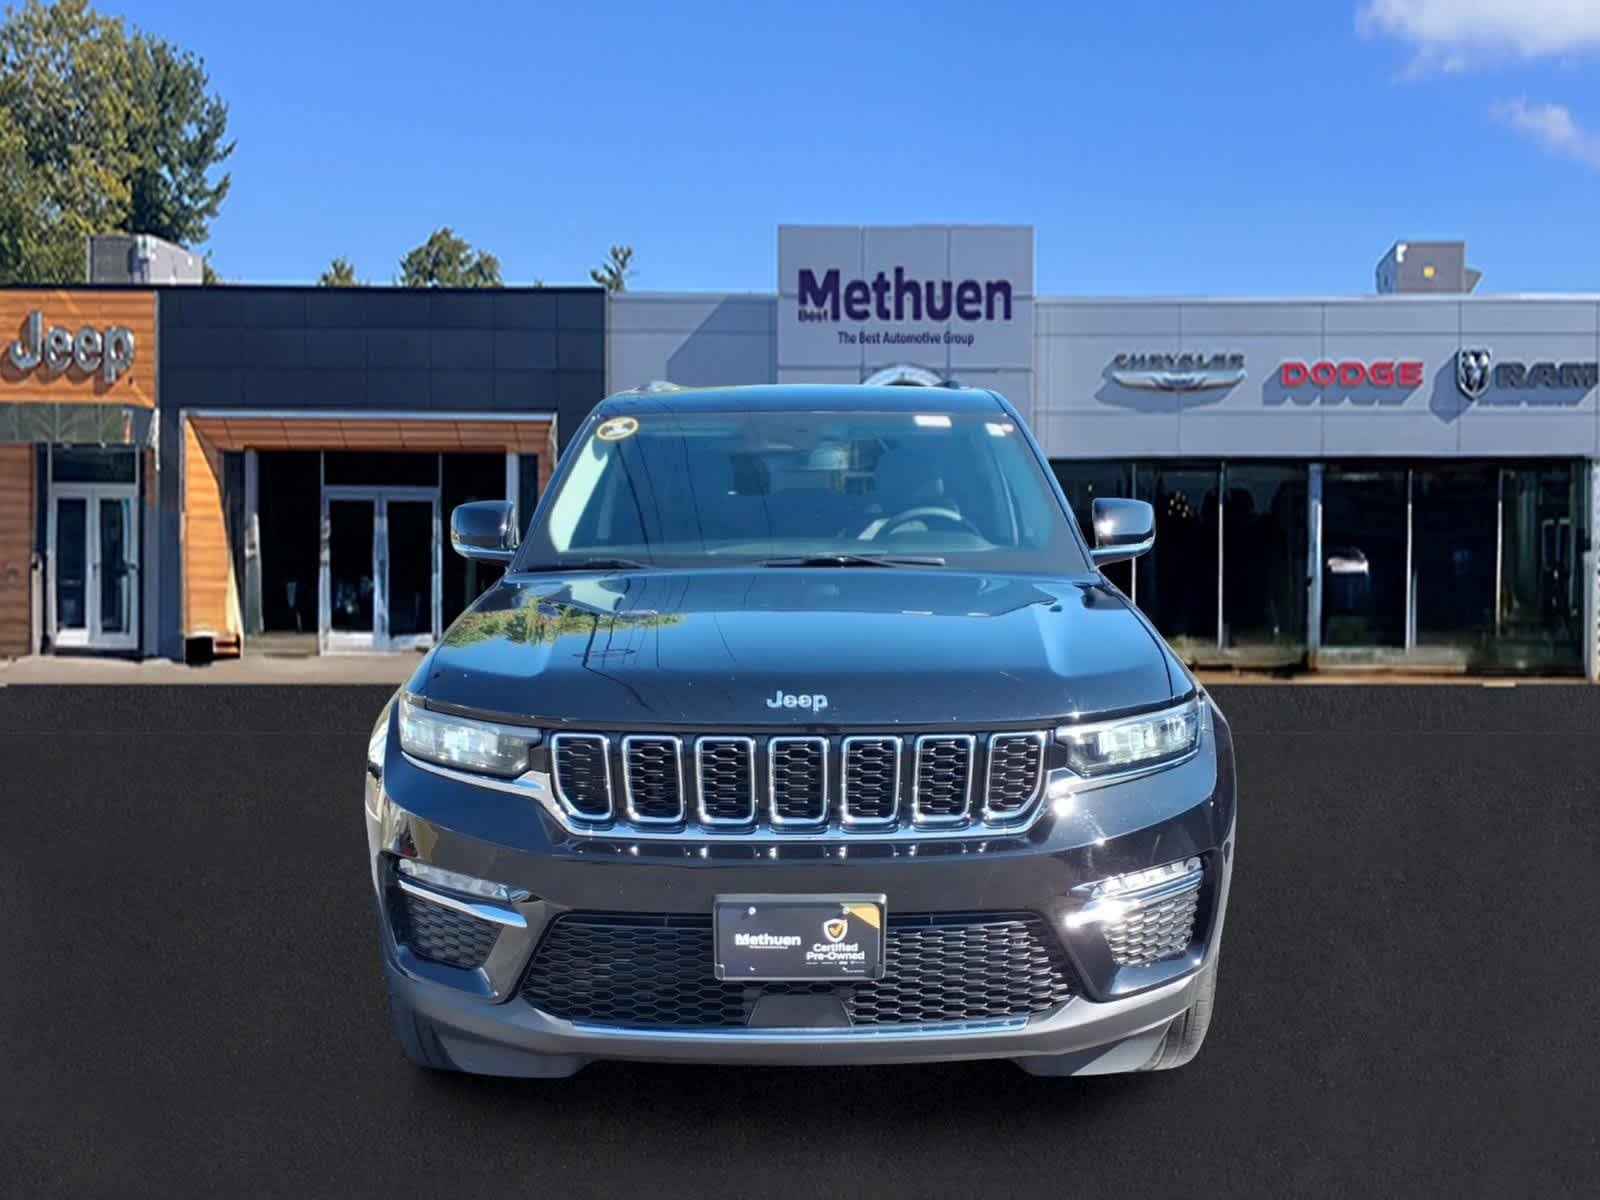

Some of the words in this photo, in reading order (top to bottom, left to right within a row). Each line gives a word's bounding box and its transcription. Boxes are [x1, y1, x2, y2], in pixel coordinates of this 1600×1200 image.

[798, 266, 1012, 322] Methuen
[798, 309, 828, 323] Best
[9, 310, 135, 383] Jeep
[837, 331, 857, 345] The
[859, 331, 881, 345] Best
[883, 331, 941, 345] Automotive
[943, 331, 975, 348] Group
[1113, 353, 1245, 370] CHRYSLER
[1280, 361, 1424, 387] DODGE
[1495, 362, 1598, 389] RAM
[765, 690, 829, 712] Jeep
[734, 932, 802, 946] Methuen
[812, 942, 859, 952] Certified
[805, 950, 866, 961] Pre-Owned
